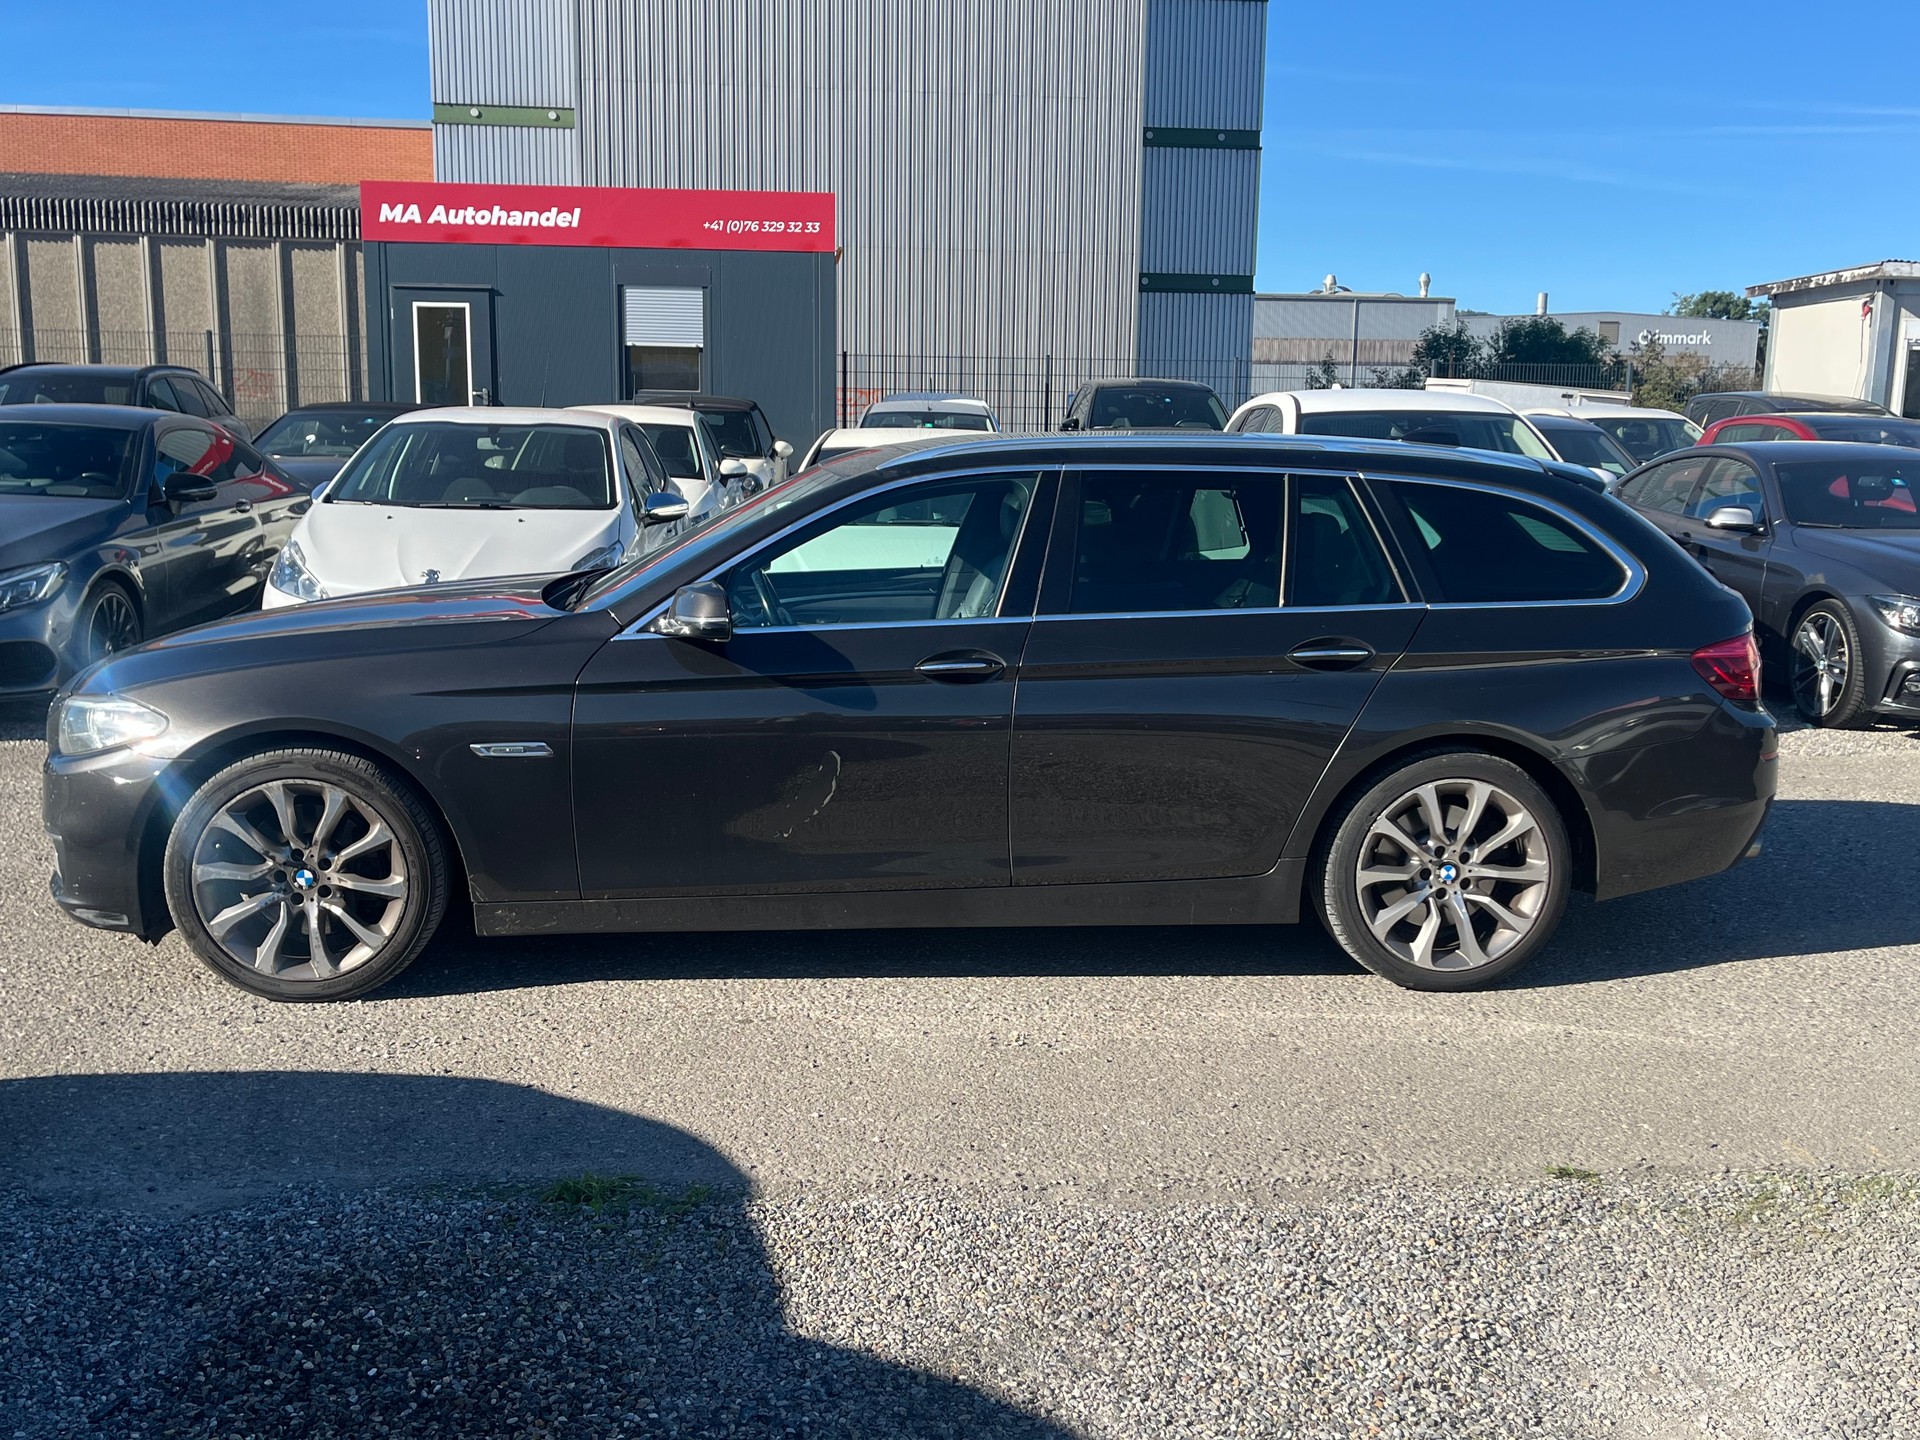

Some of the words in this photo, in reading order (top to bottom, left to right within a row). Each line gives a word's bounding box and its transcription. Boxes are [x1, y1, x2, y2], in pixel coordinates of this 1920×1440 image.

[379, 203, 421, 224] MA
[427, 204, 581, 228] Autohandel
[703, 220, 724, 231] +41
[727, 220, 759, 234] (0)76
[761, 221, 785, 232] 329
[786, 222, 803, 233] 32
[804, 222, 821, 233] 33
